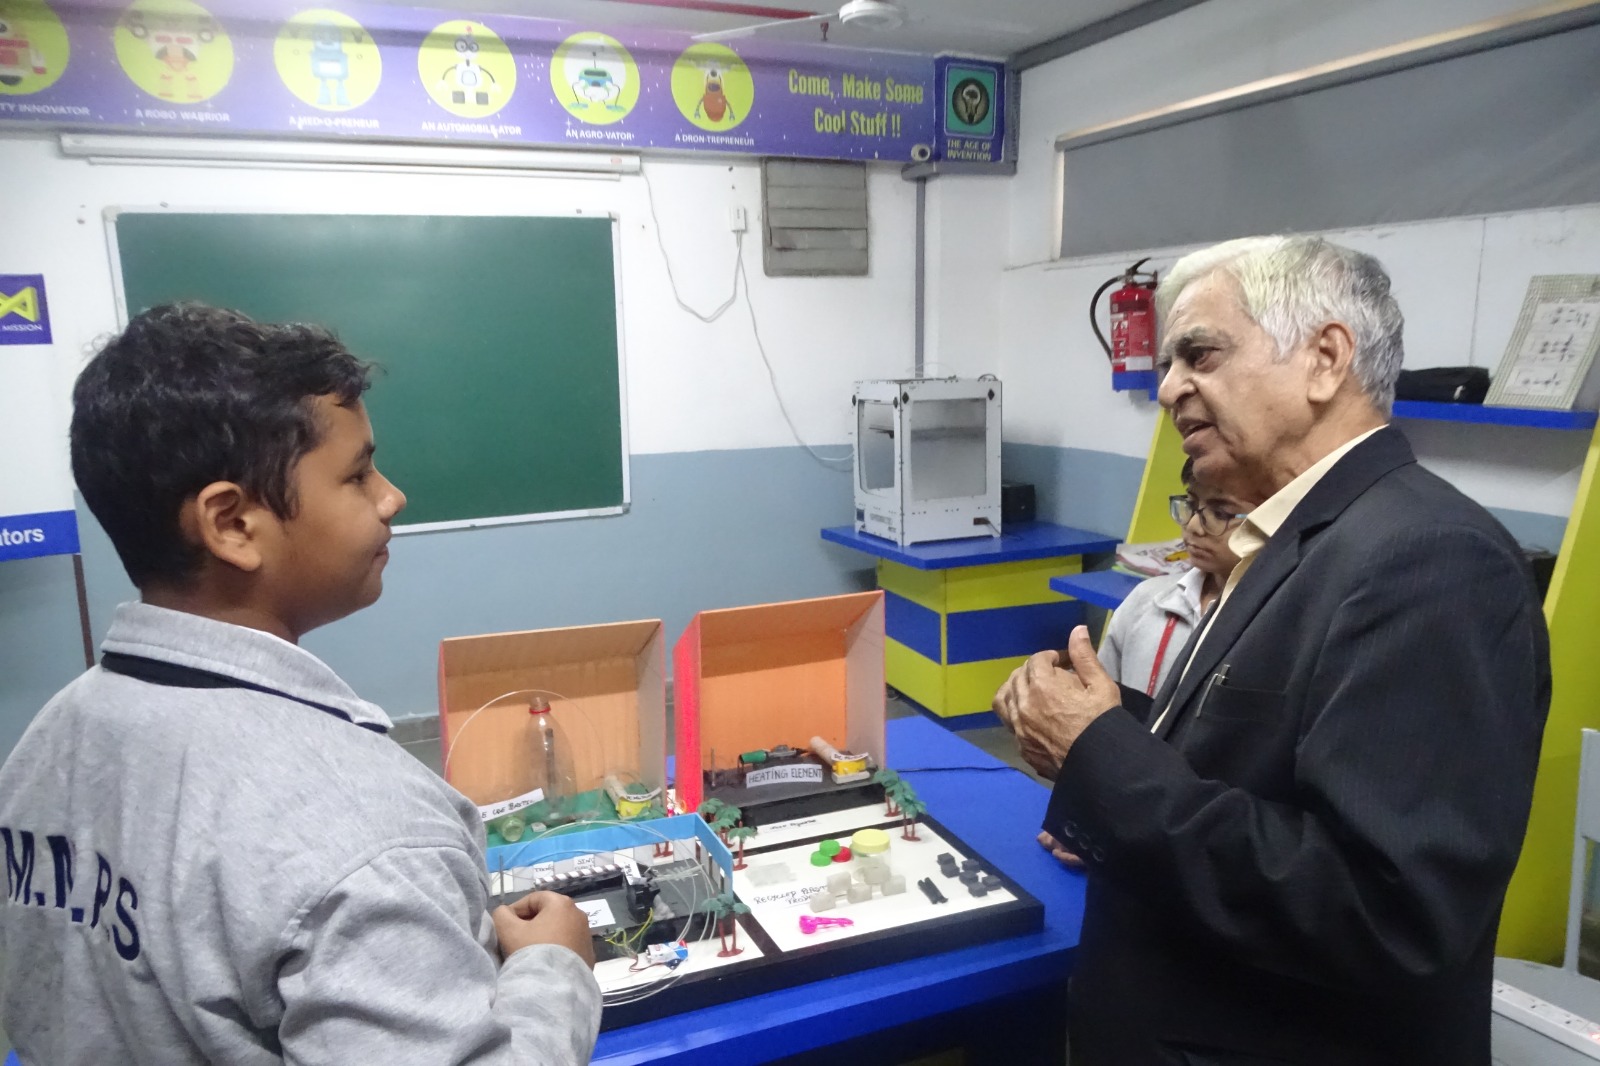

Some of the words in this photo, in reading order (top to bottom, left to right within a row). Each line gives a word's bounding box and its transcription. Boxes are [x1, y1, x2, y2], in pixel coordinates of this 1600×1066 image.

[788, 68, 834, 100] Come,
[842, 72, 881, 100] Make
[885, 77, 924, 104] Some
[18, 104, 91, 116] INNOVATOR
[135, 108, 144, 118] A
[145, 108, 177, 120] ROBO
[180, 111, 230, 122] WARRIOR
[421, 121, 436, 132] AN
[814, 107, 846, 133] Cool
[850, 110, 888, 137] Stuff
[565, 129, 578, 139] AN
[674, 133, 681, 142] A
[947, 139, 961, 148] THE
[963, 140, 979, 149] AGE
[981, 142, 992, 151] OF
[947, 149, 992, 162] INVENTION
[2, 323, 43, 331] MISSION
[748, 768, 789, 784] HEATING
[790, 768, 822, 779] ELEMENT
